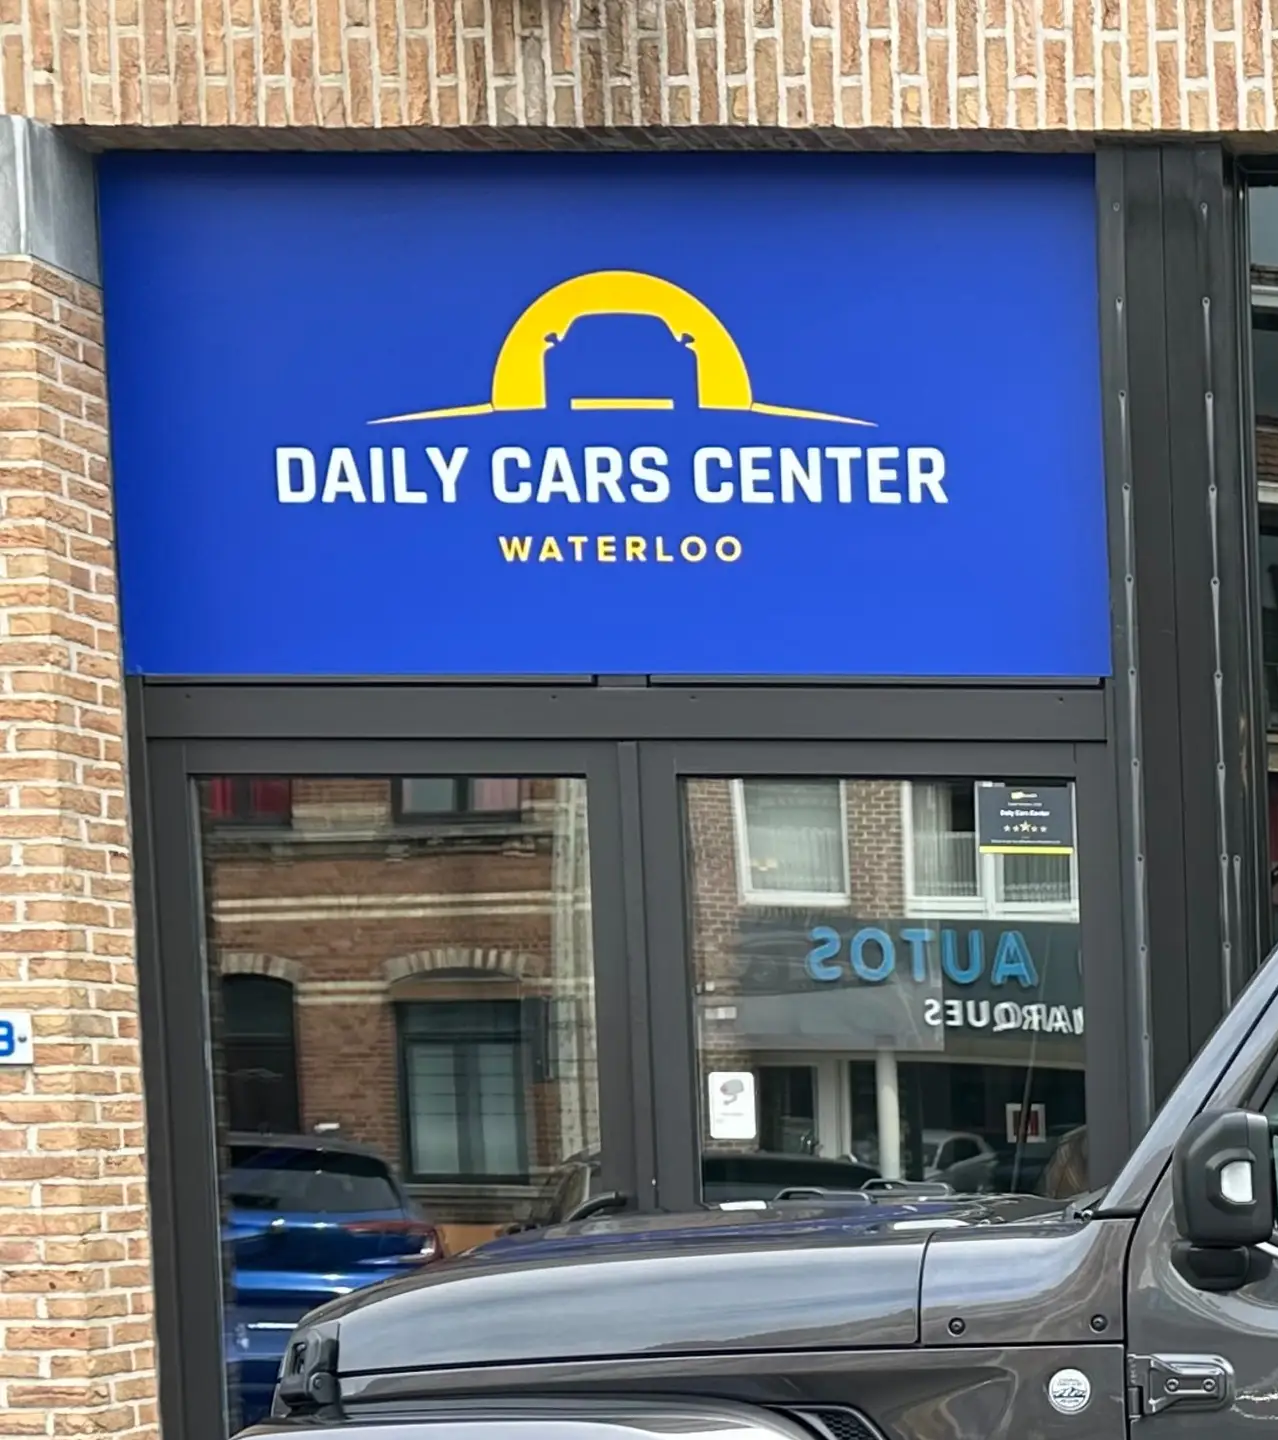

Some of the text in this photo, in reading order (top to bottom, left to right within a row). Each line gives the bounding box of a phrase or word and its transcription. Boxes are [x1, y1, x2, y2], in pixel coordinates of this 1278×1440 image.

[276, 446, 949, 505] DAILY CARS CENTER
[500, 535, 743, 563] WATERLOO
